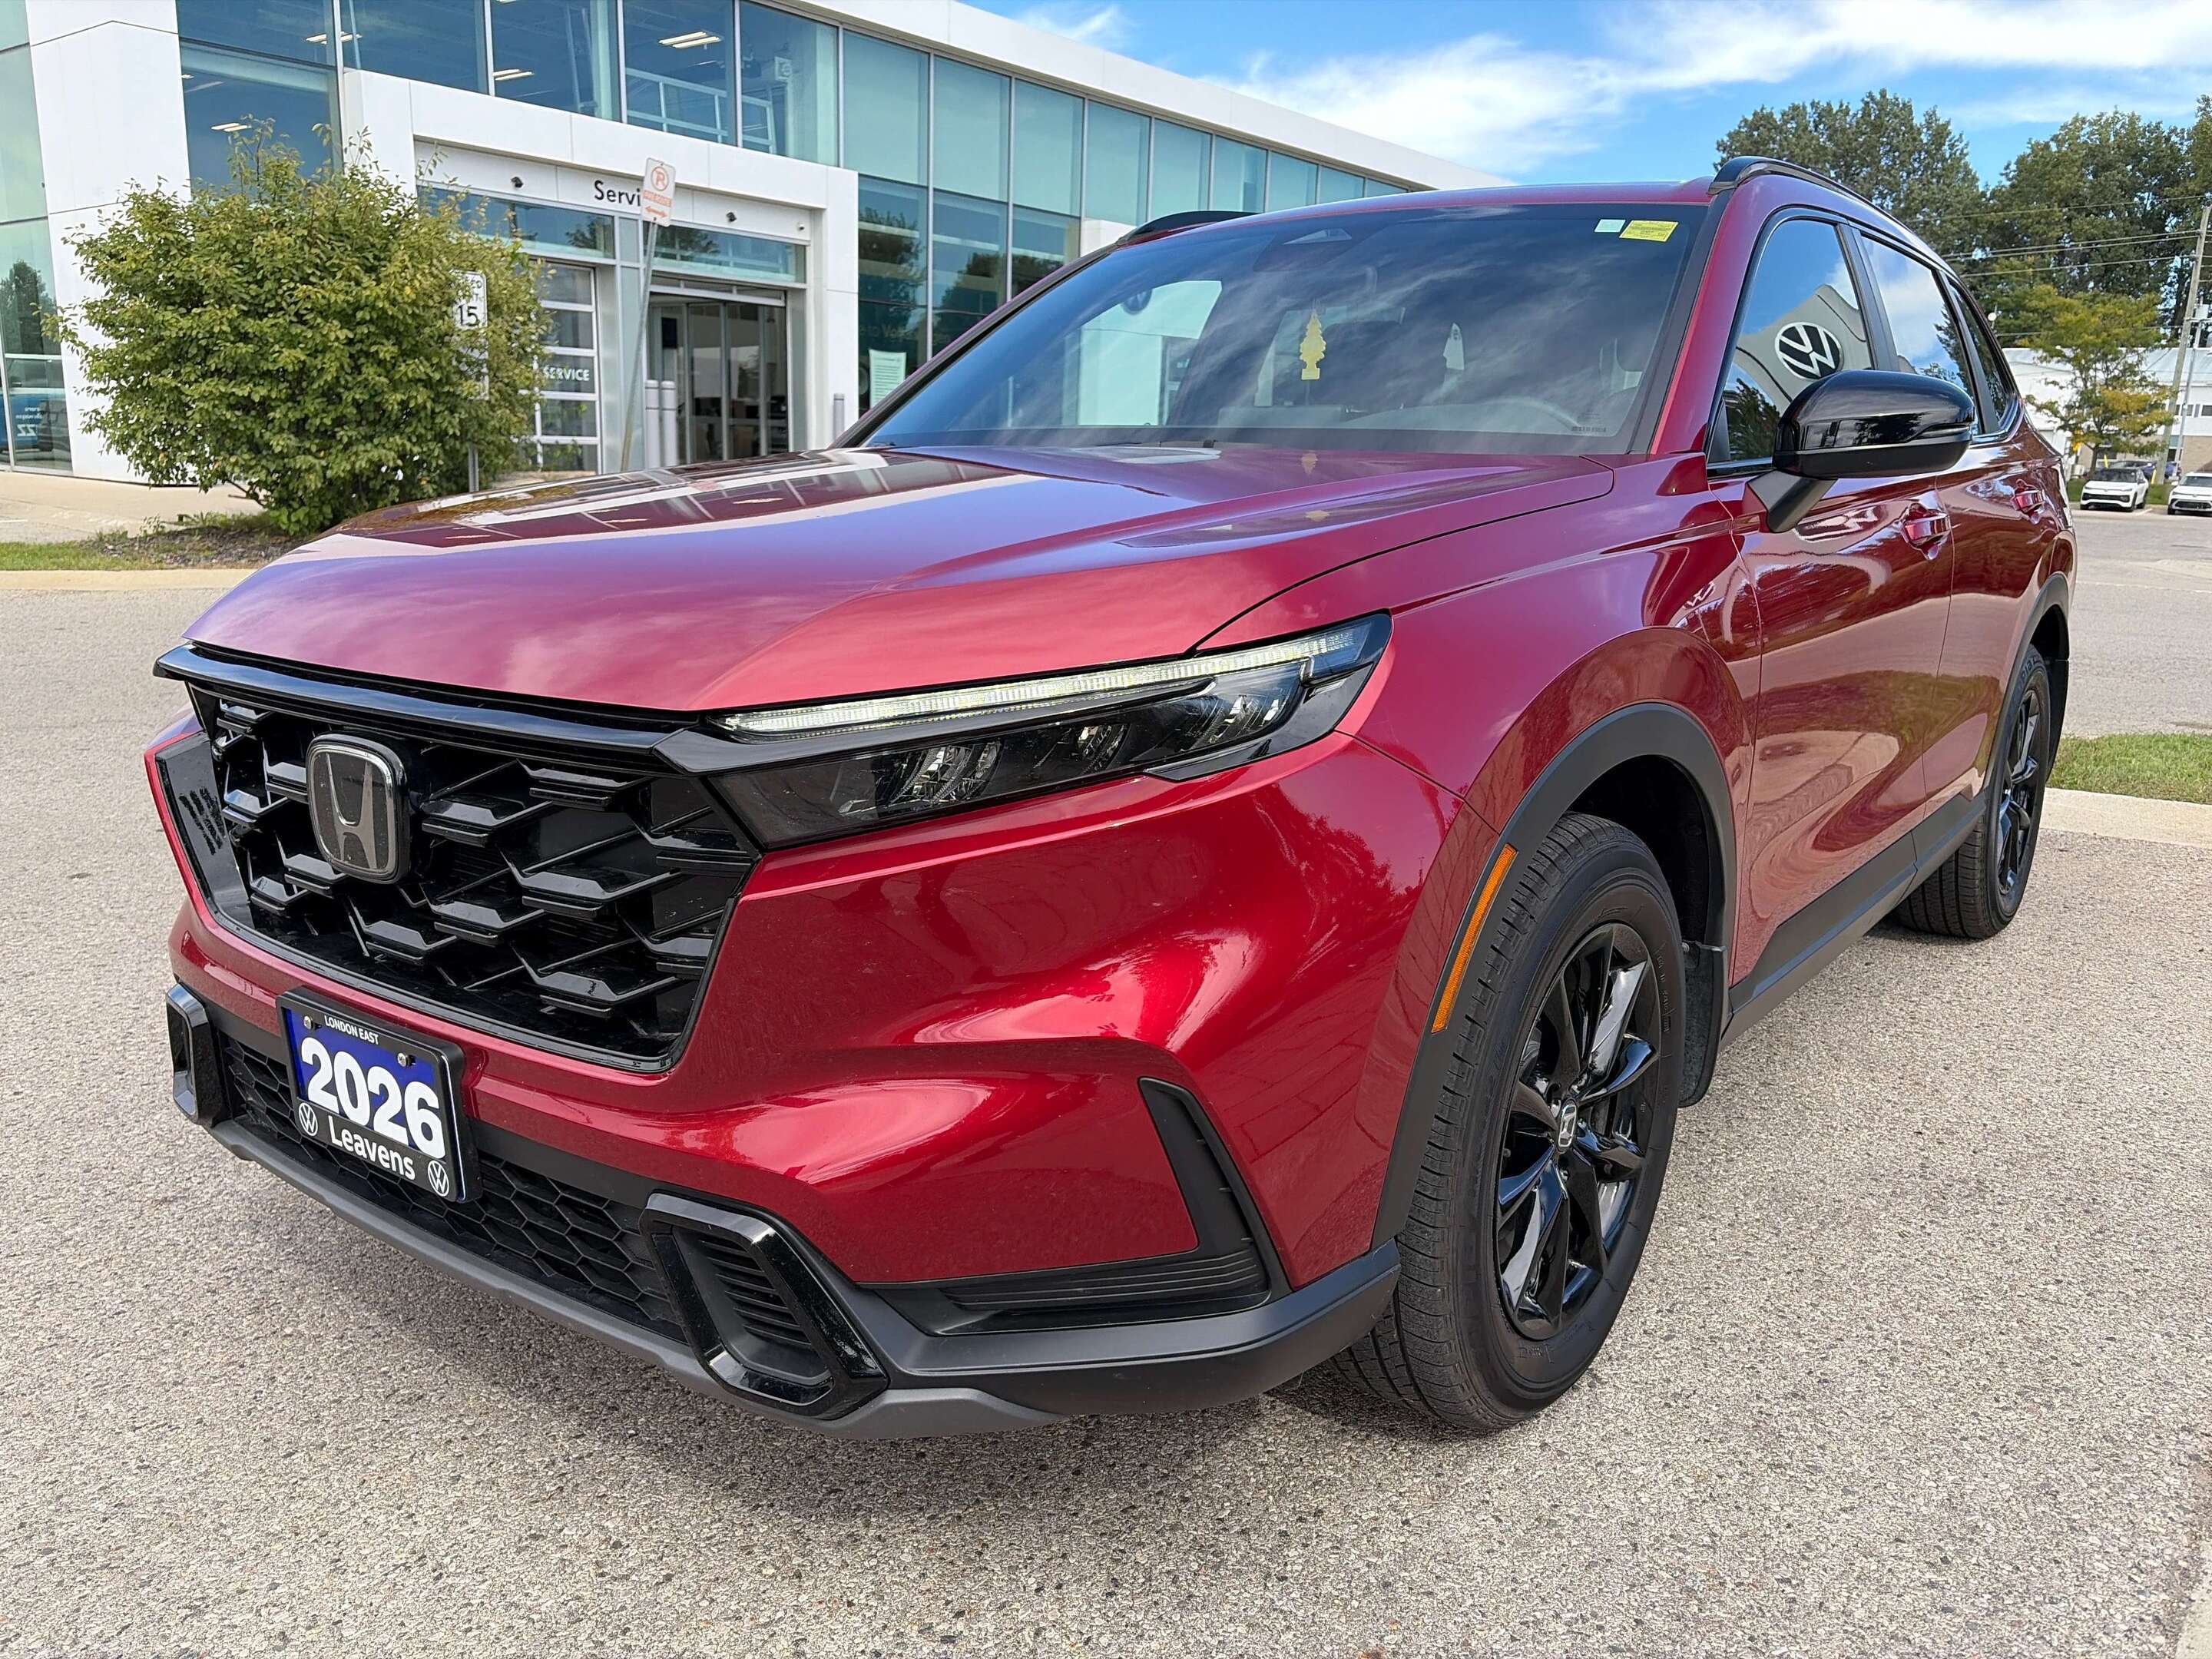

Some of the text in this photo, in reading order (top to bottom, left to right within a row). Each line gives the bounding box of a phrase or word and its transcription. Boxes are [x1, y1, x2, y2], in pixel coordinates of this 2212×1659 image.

[594, 179, 641, 207] Servi
[458, 304, 480, 327] 15
[542, 365, 590, 382] SERVICE
[324, 1015, 379, 1045] LONDON EAST
[300, 1037, 446, 1160] 2026
[327, 1114, 416, 1181] Leavens
